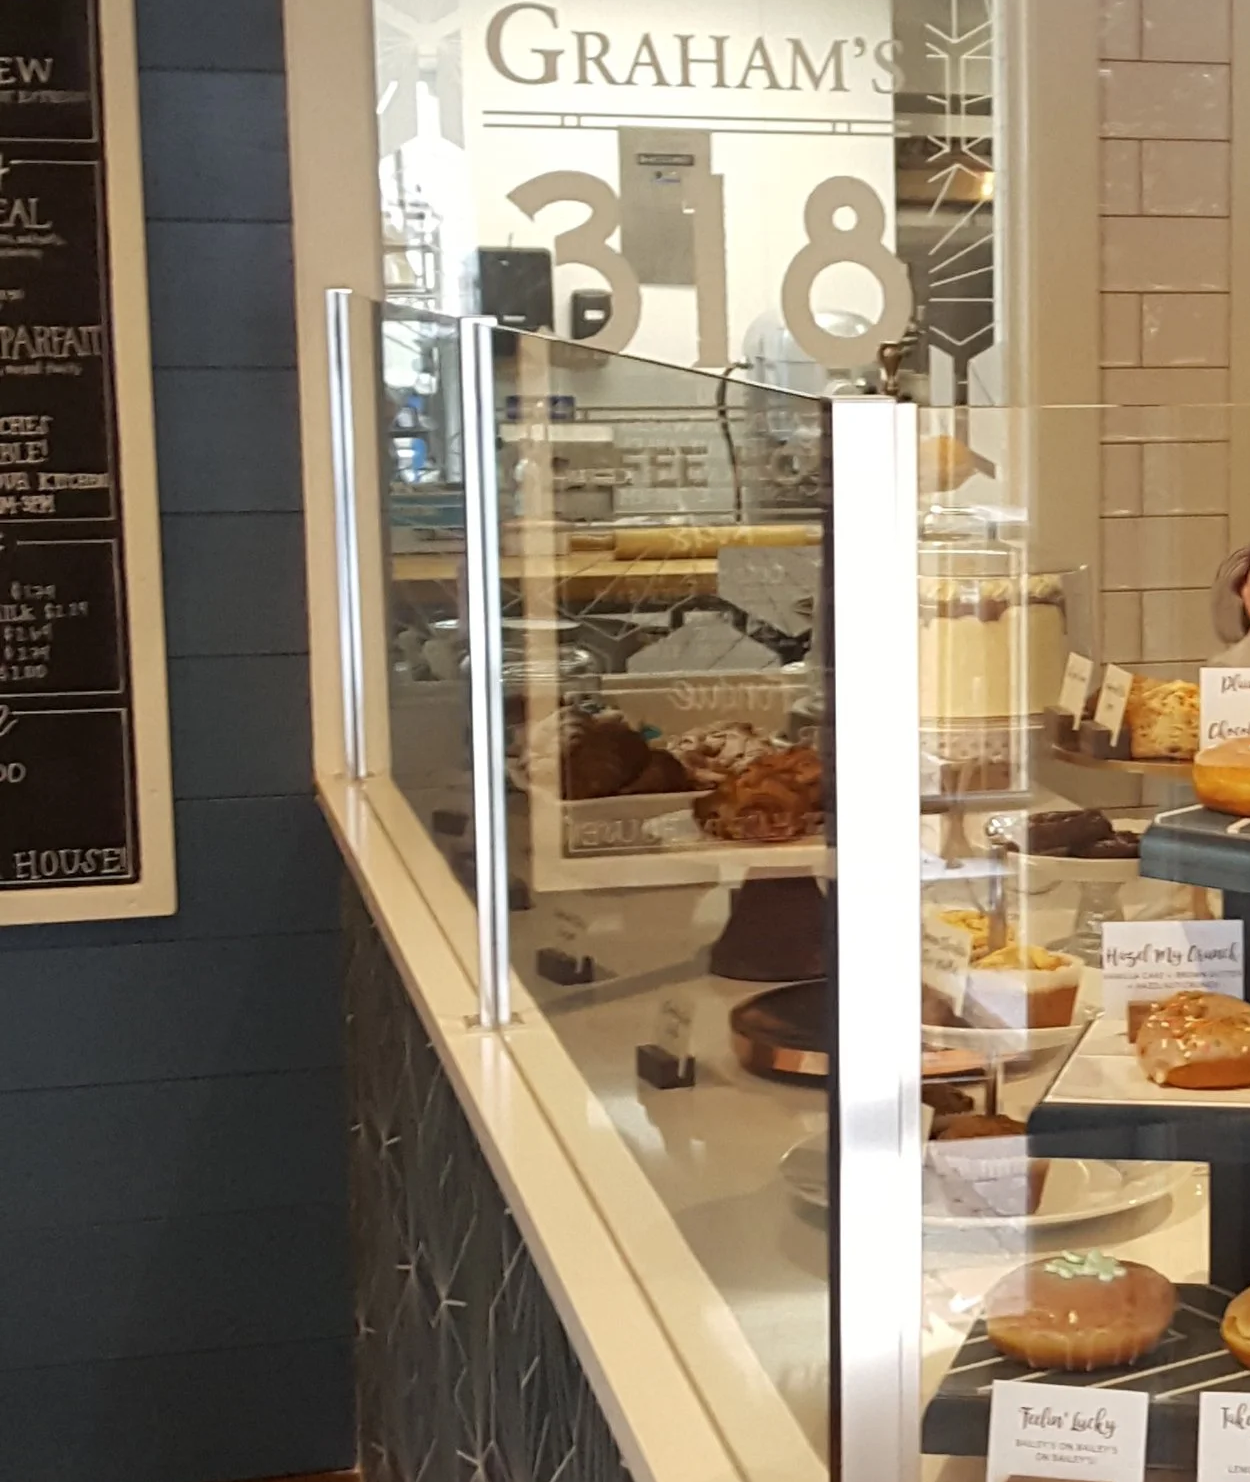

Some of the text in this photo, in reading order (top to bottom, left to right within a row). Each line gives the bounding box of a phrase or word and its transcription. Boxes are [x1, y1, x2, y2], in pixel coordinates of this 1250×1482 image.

[484, 1, 905, 95] GRAHAM'S
[507, 170, 914, 369] 318
[0, 323, 102, 360] PARFAIT
[1106, 942, 1240, 968] Hazel My Crunch
[1019, 1406, 1117, 1439] Feelin' Lucky
